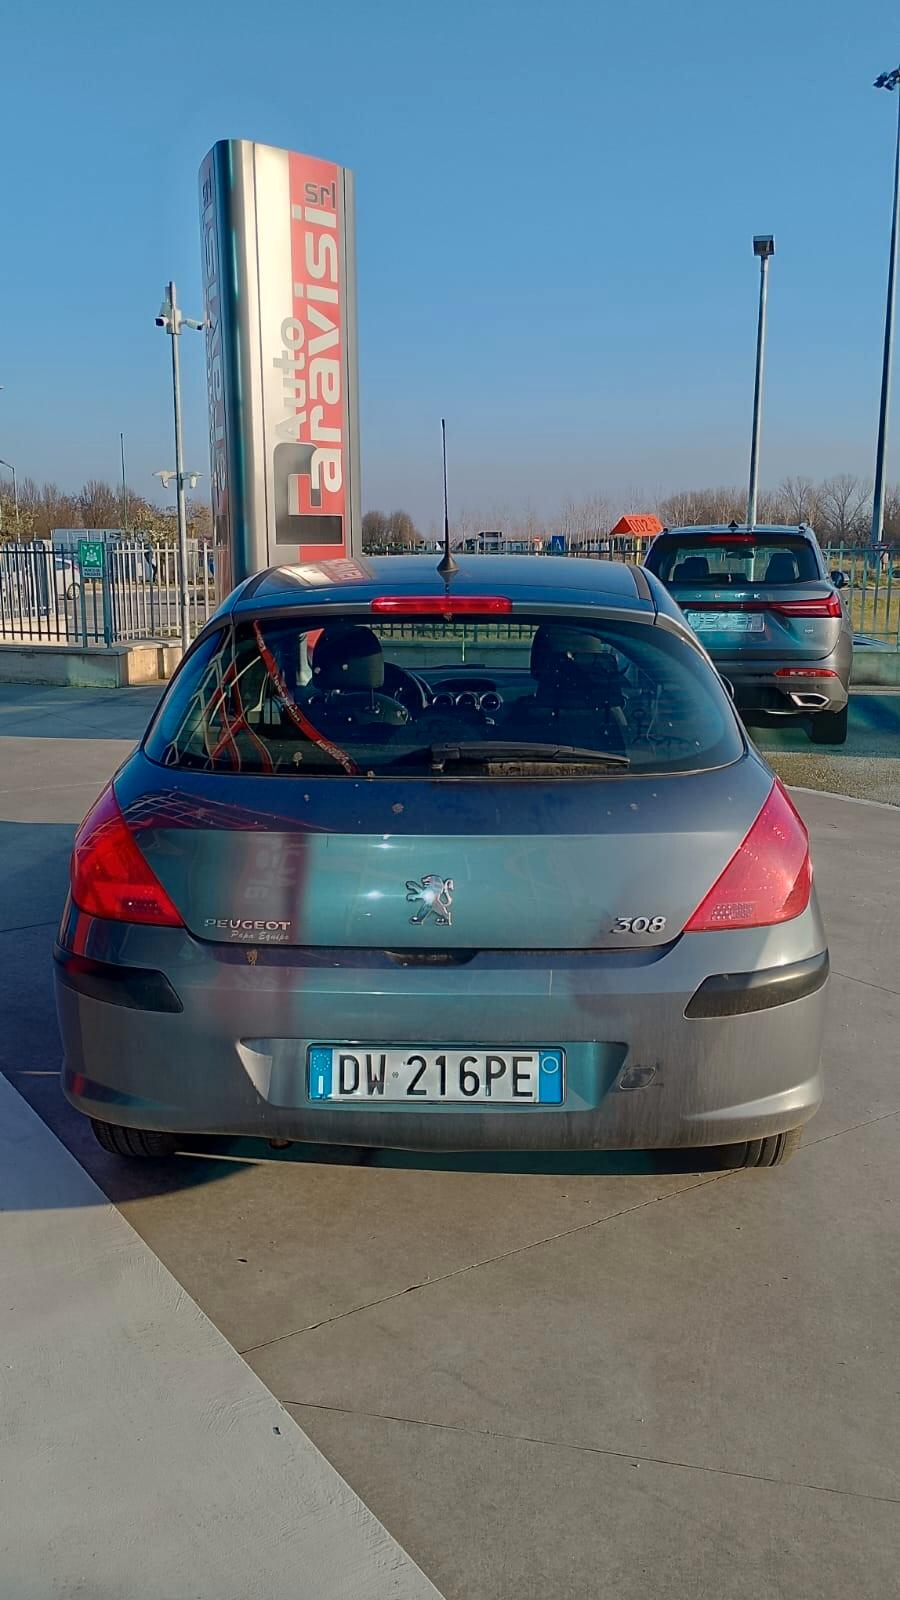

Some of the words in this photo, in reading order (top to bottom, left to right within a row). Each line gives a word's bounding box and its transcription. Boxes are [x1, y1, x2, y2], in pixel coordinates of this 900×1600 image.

[304, 182, 337, 209] srl
[273, 203, 344, 546] Paravisi
[273, 316, 306, 443] Auto
[204, 918, 291, 931] PEUGEOT
[610, 916, 667, 934] 308
[339, 1054, 387, 1096] DW
[406, 1054, 533, 1097] 216PE
